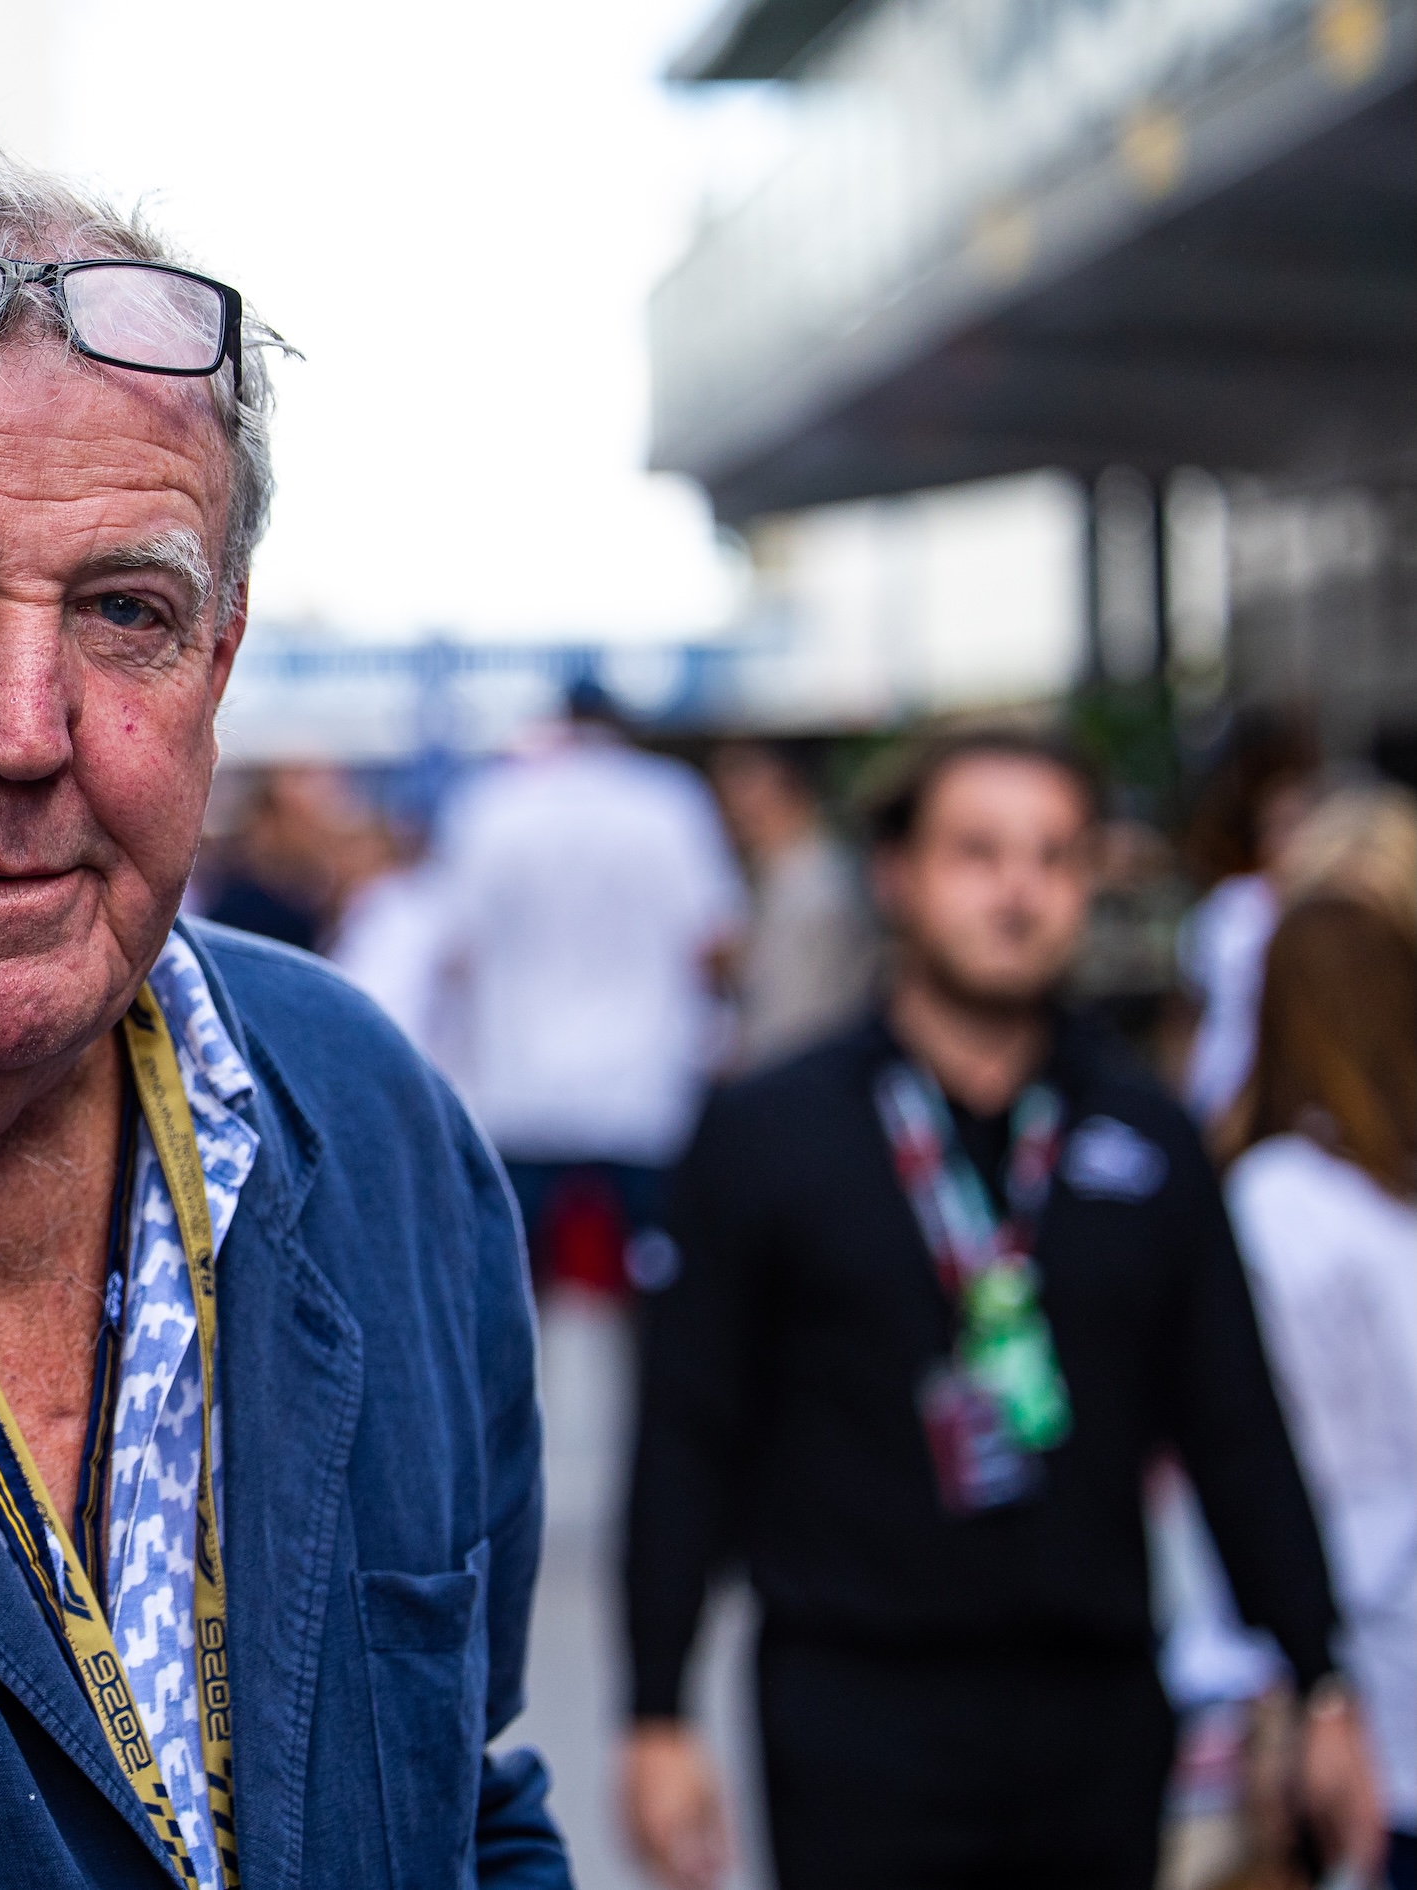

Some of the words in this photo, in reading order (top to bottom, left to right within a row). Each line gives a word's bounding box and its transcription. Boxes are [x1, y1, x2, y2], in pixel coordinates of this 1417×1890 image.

[200, 1253, 214, 1297] FIA
[84, 1651, 153, 1774] 2026
[198, 1618, 231, 1742] 2026
